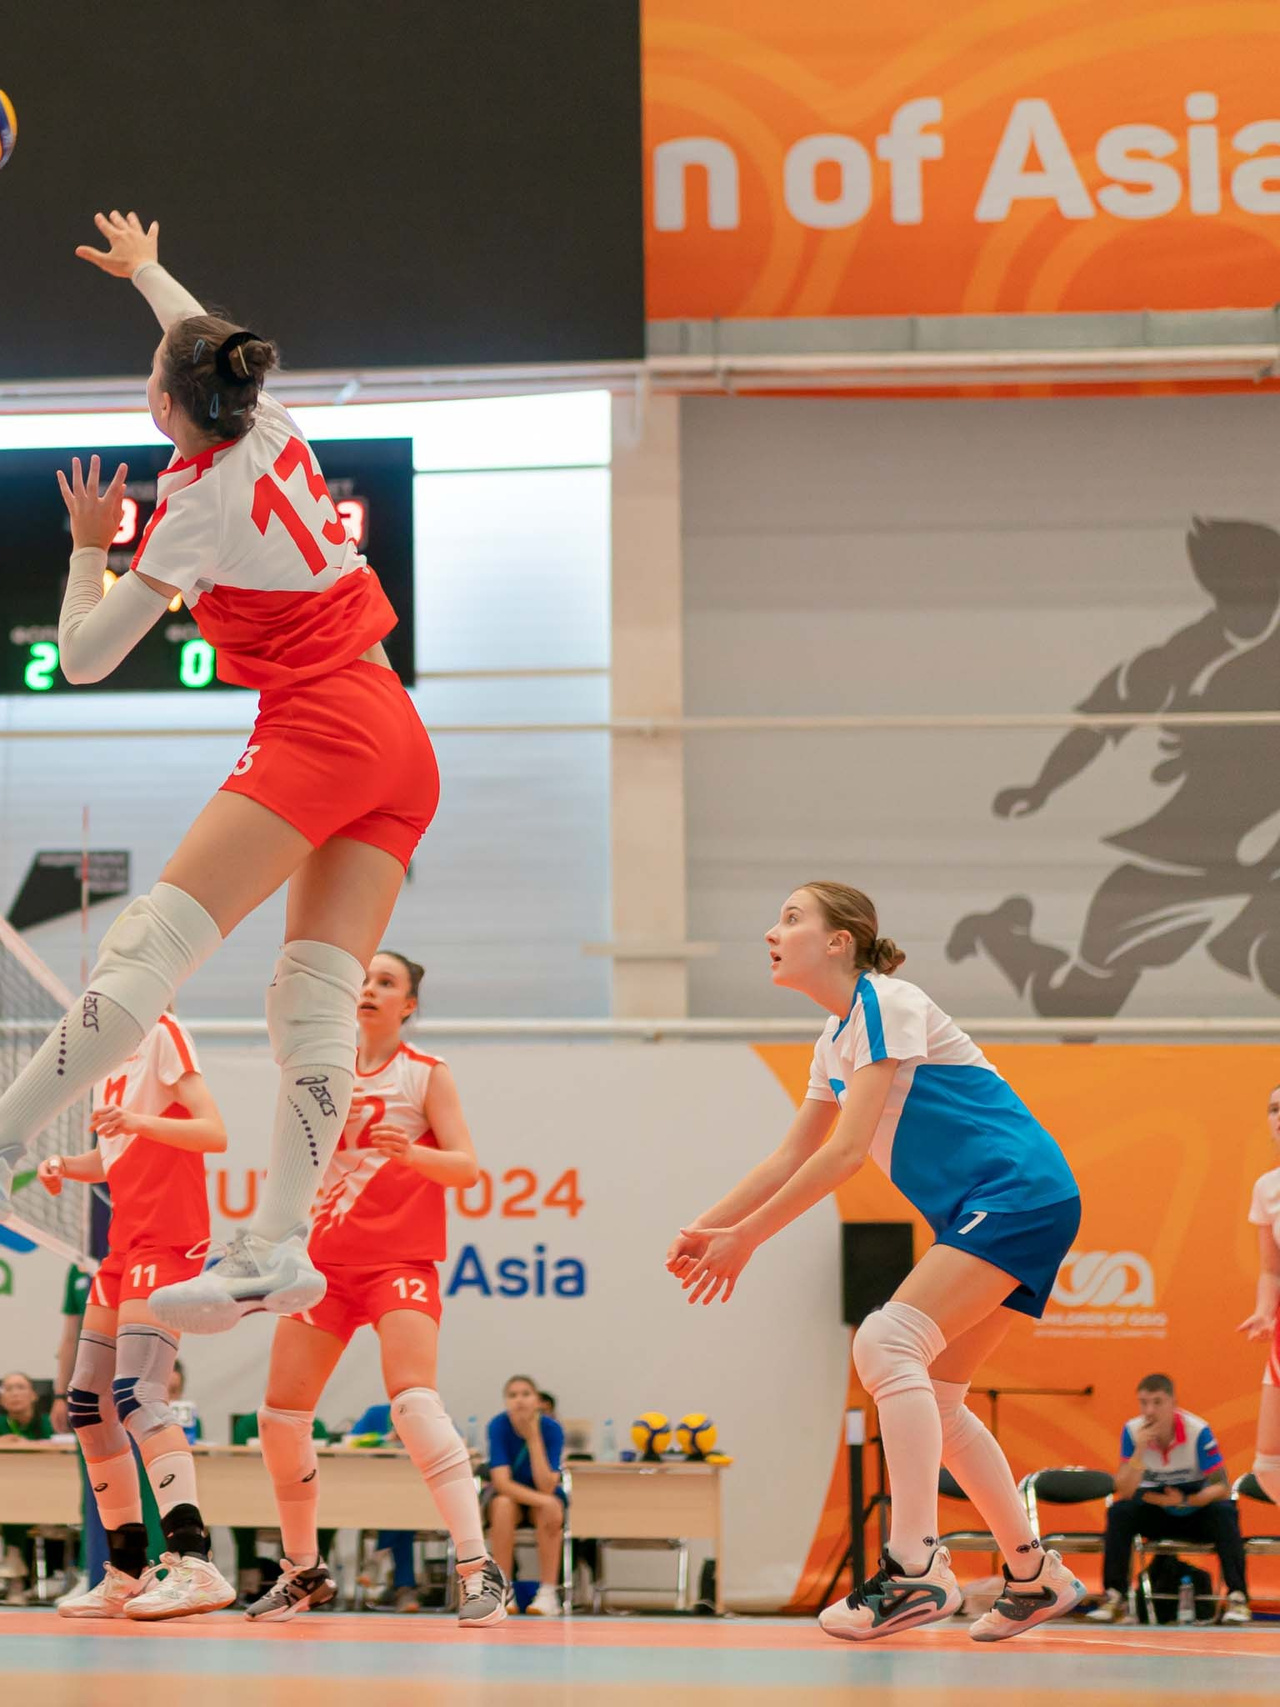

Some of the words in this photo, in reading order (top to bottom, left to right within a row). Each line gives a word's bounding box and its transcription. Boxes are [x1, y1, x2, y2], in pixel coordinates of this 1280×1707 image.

[783, 97, 944, 228] of
[250, 434, 348, 576] 13
[24, 641, 60, 691] 2
[180, 639, 216, 689] 0
[302, 1079, 337, 1117] asics
[130, 1264, 157, 1287] 11
[392, 1277, 428, 1302] 12
[447, 1244, 586, 1297] Asia
